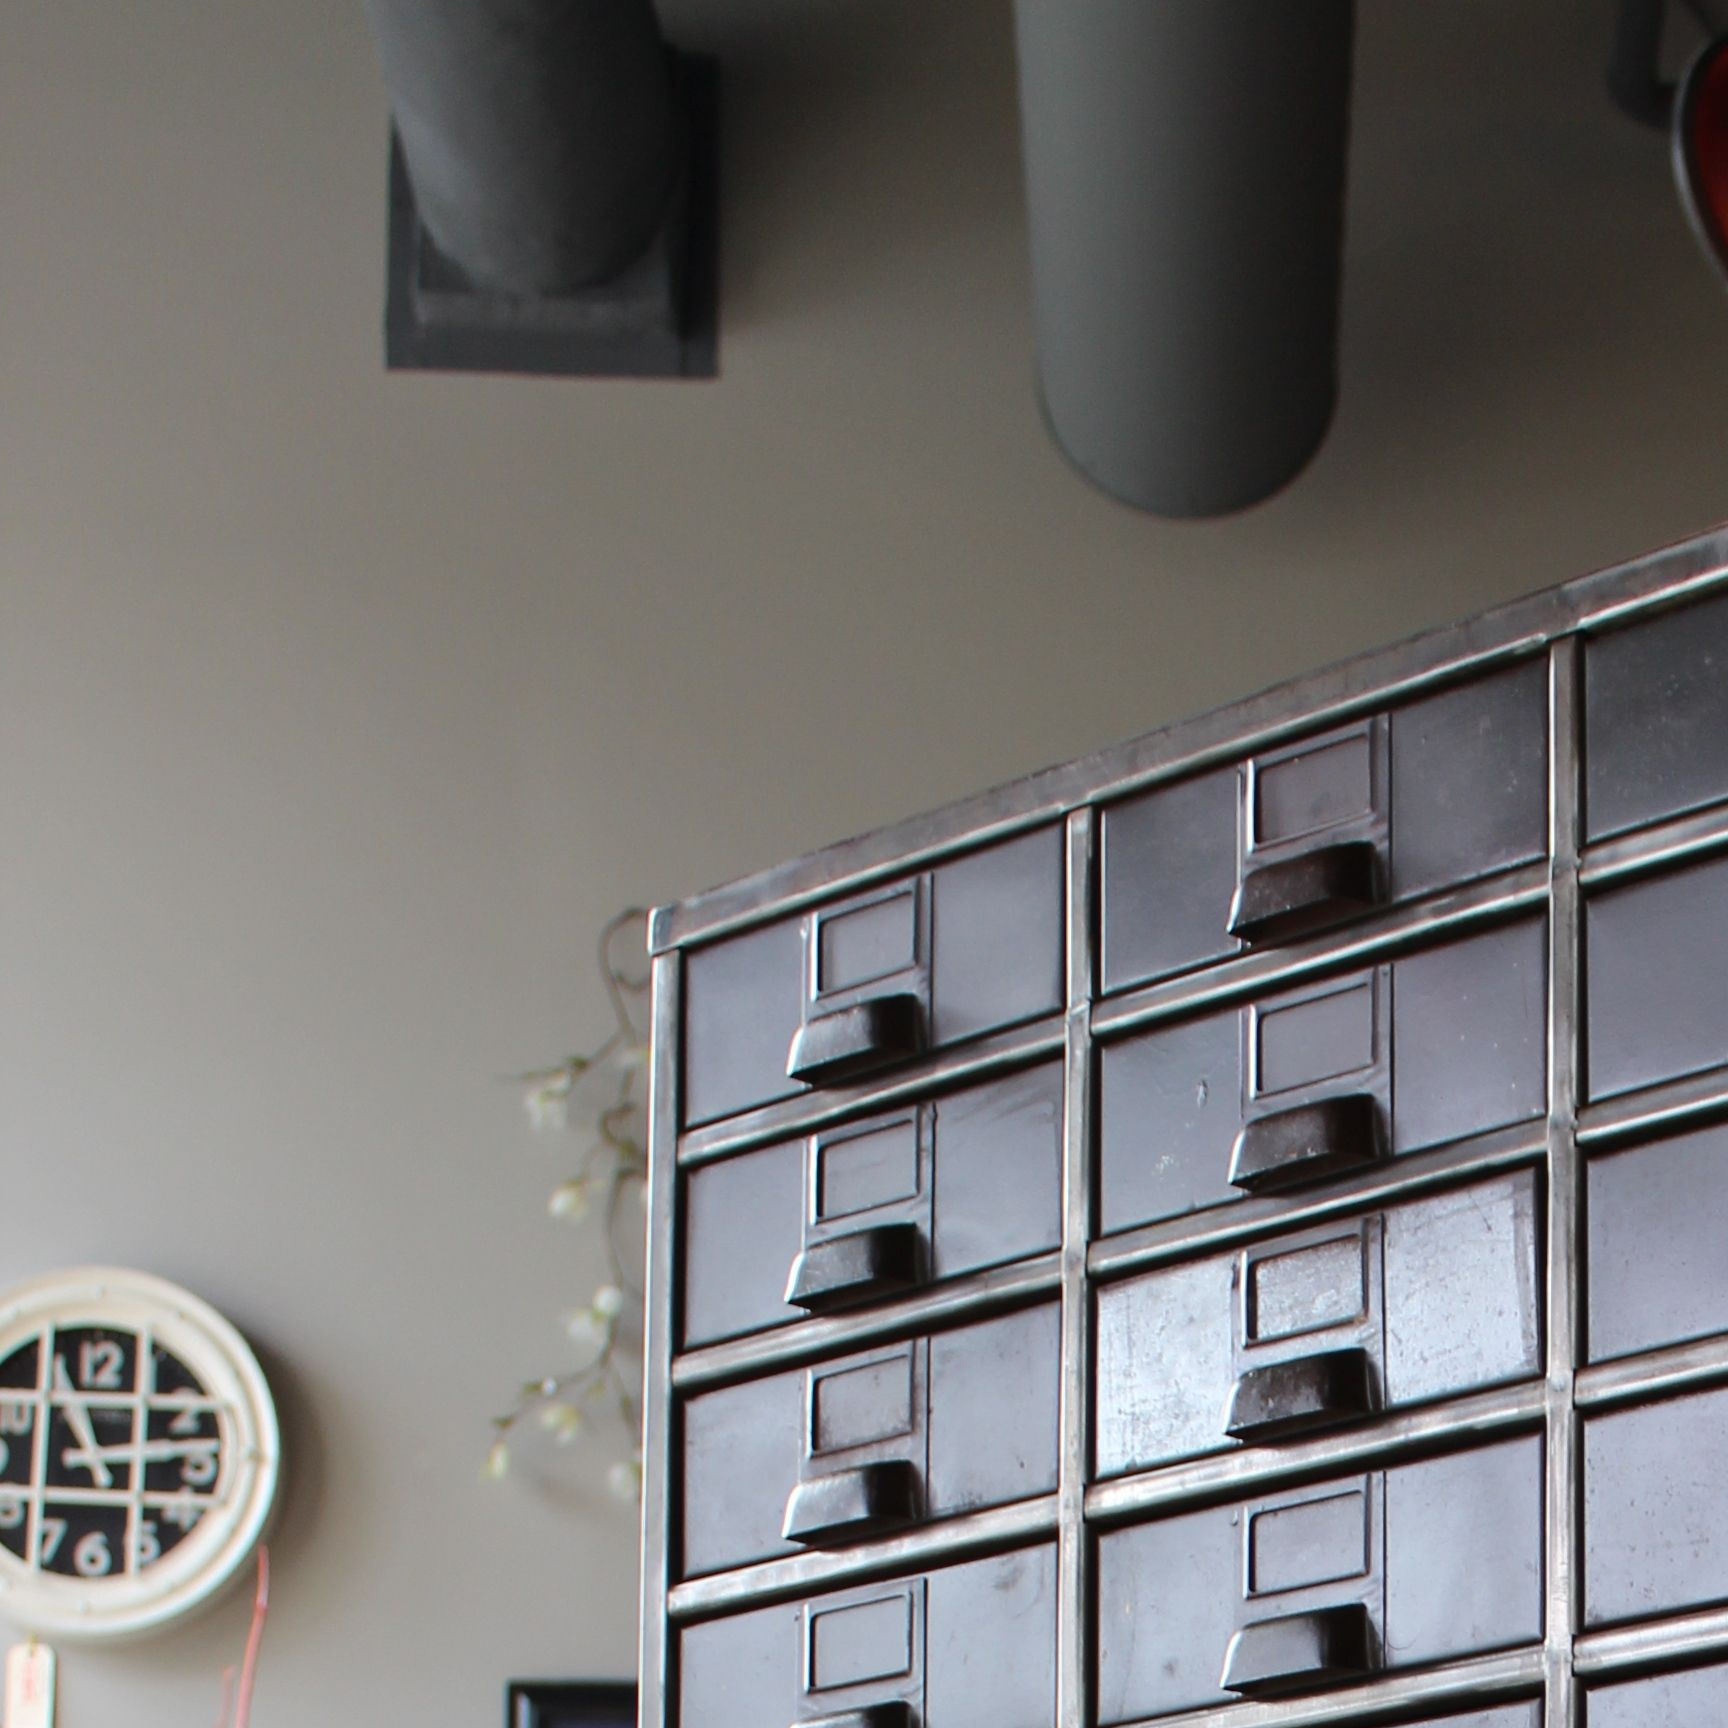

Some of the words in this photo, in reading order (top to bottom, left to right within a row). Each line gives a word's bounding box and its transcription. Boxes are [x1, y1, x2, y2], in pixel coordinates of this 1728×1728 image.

[79, 1339, 125, 1389] 12
[40, 1517, 69, 1566] 7
[73, 1530, 113, 1578] 6
